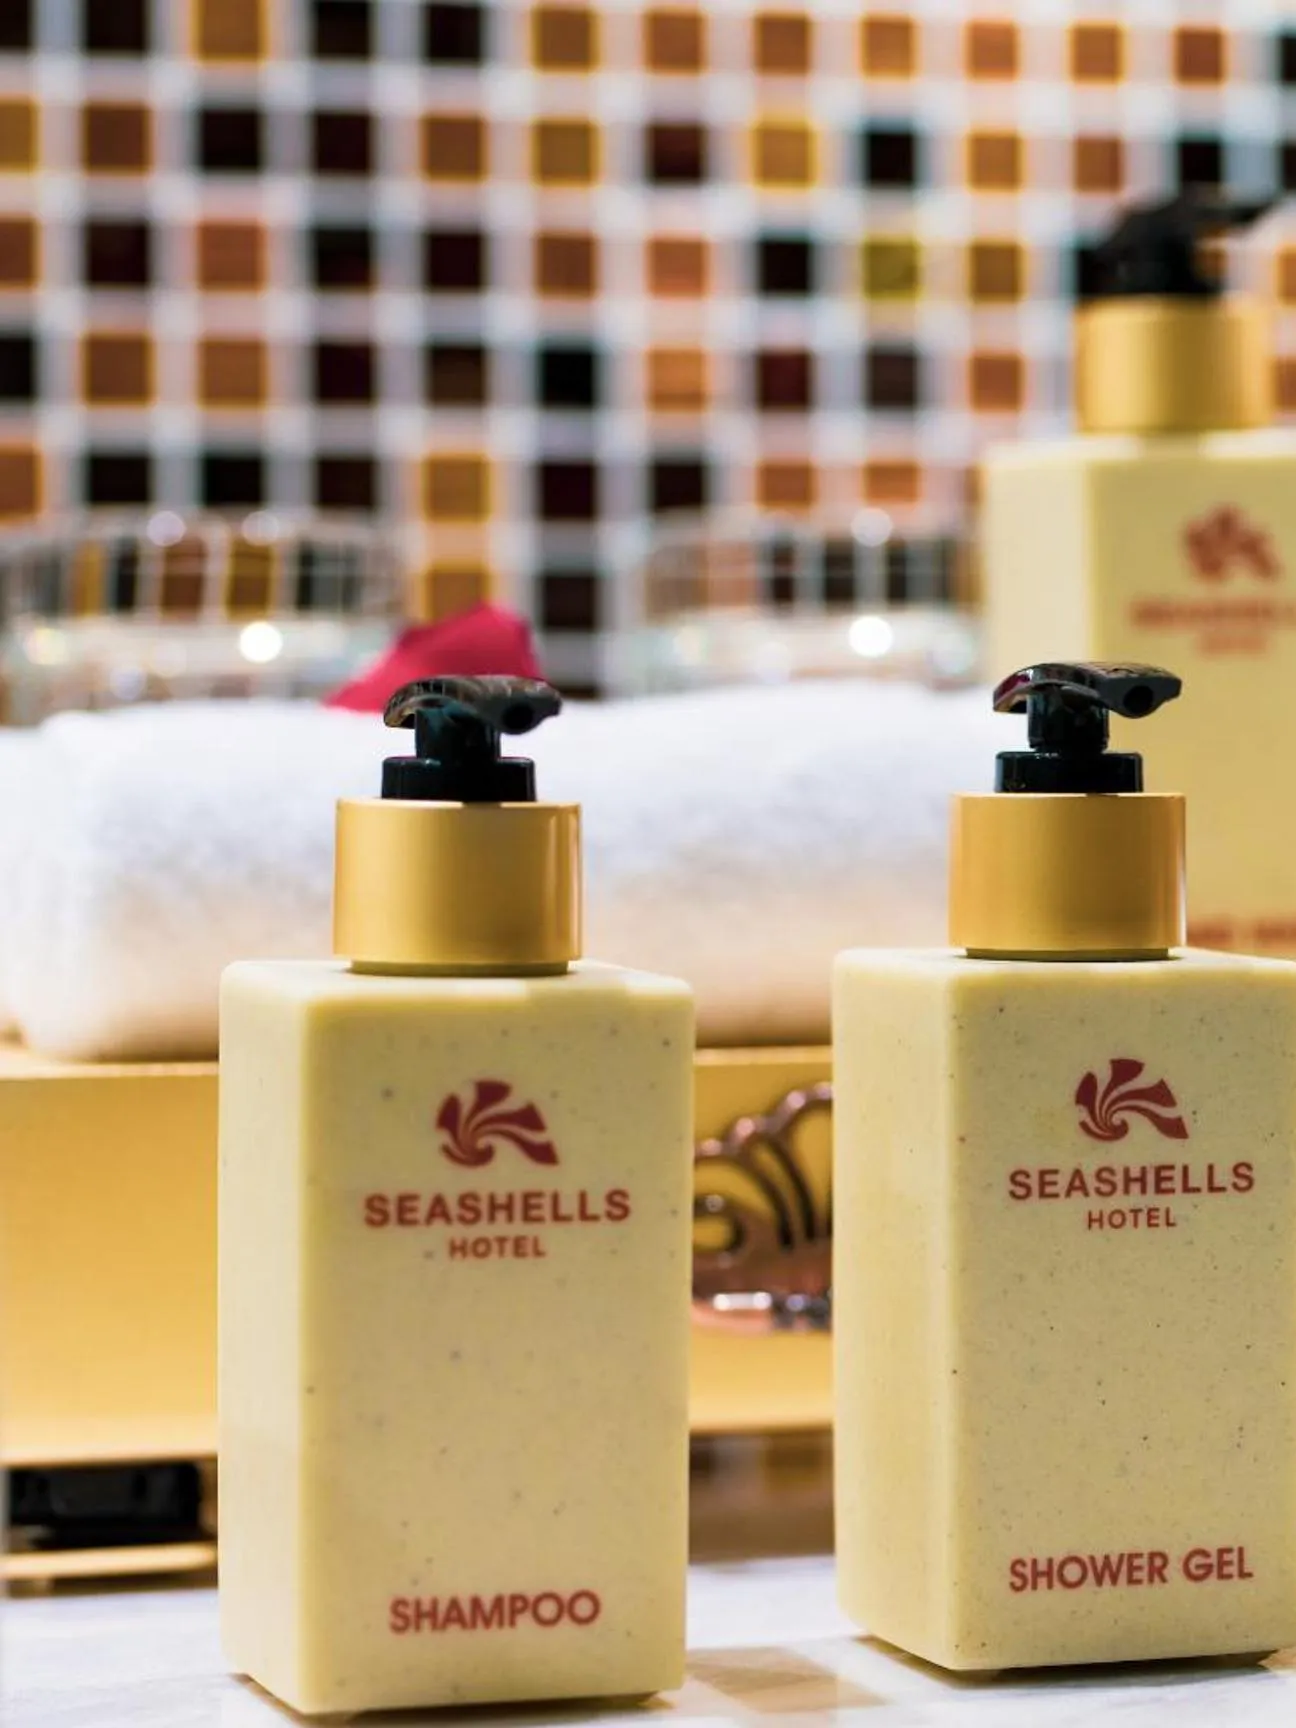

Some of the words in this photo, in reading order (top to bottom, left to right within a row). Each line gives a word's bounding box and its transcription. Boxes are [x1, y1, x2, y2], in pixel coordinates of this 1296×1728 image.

[1009, 1162, 1255, 1202] SEASHELLS
[364, 1190, 632, 1229] SEASHELLS
[1086, 1207, 1178, 1230] HOTEL
[449, 1237, 548, 1259] HOTEL
[1009, 1551, 1168, 1594] SHOWER
[1183, 1545, 1255, 1582] GEL
[390, 1589, 601, 1633] SHAMPOO
